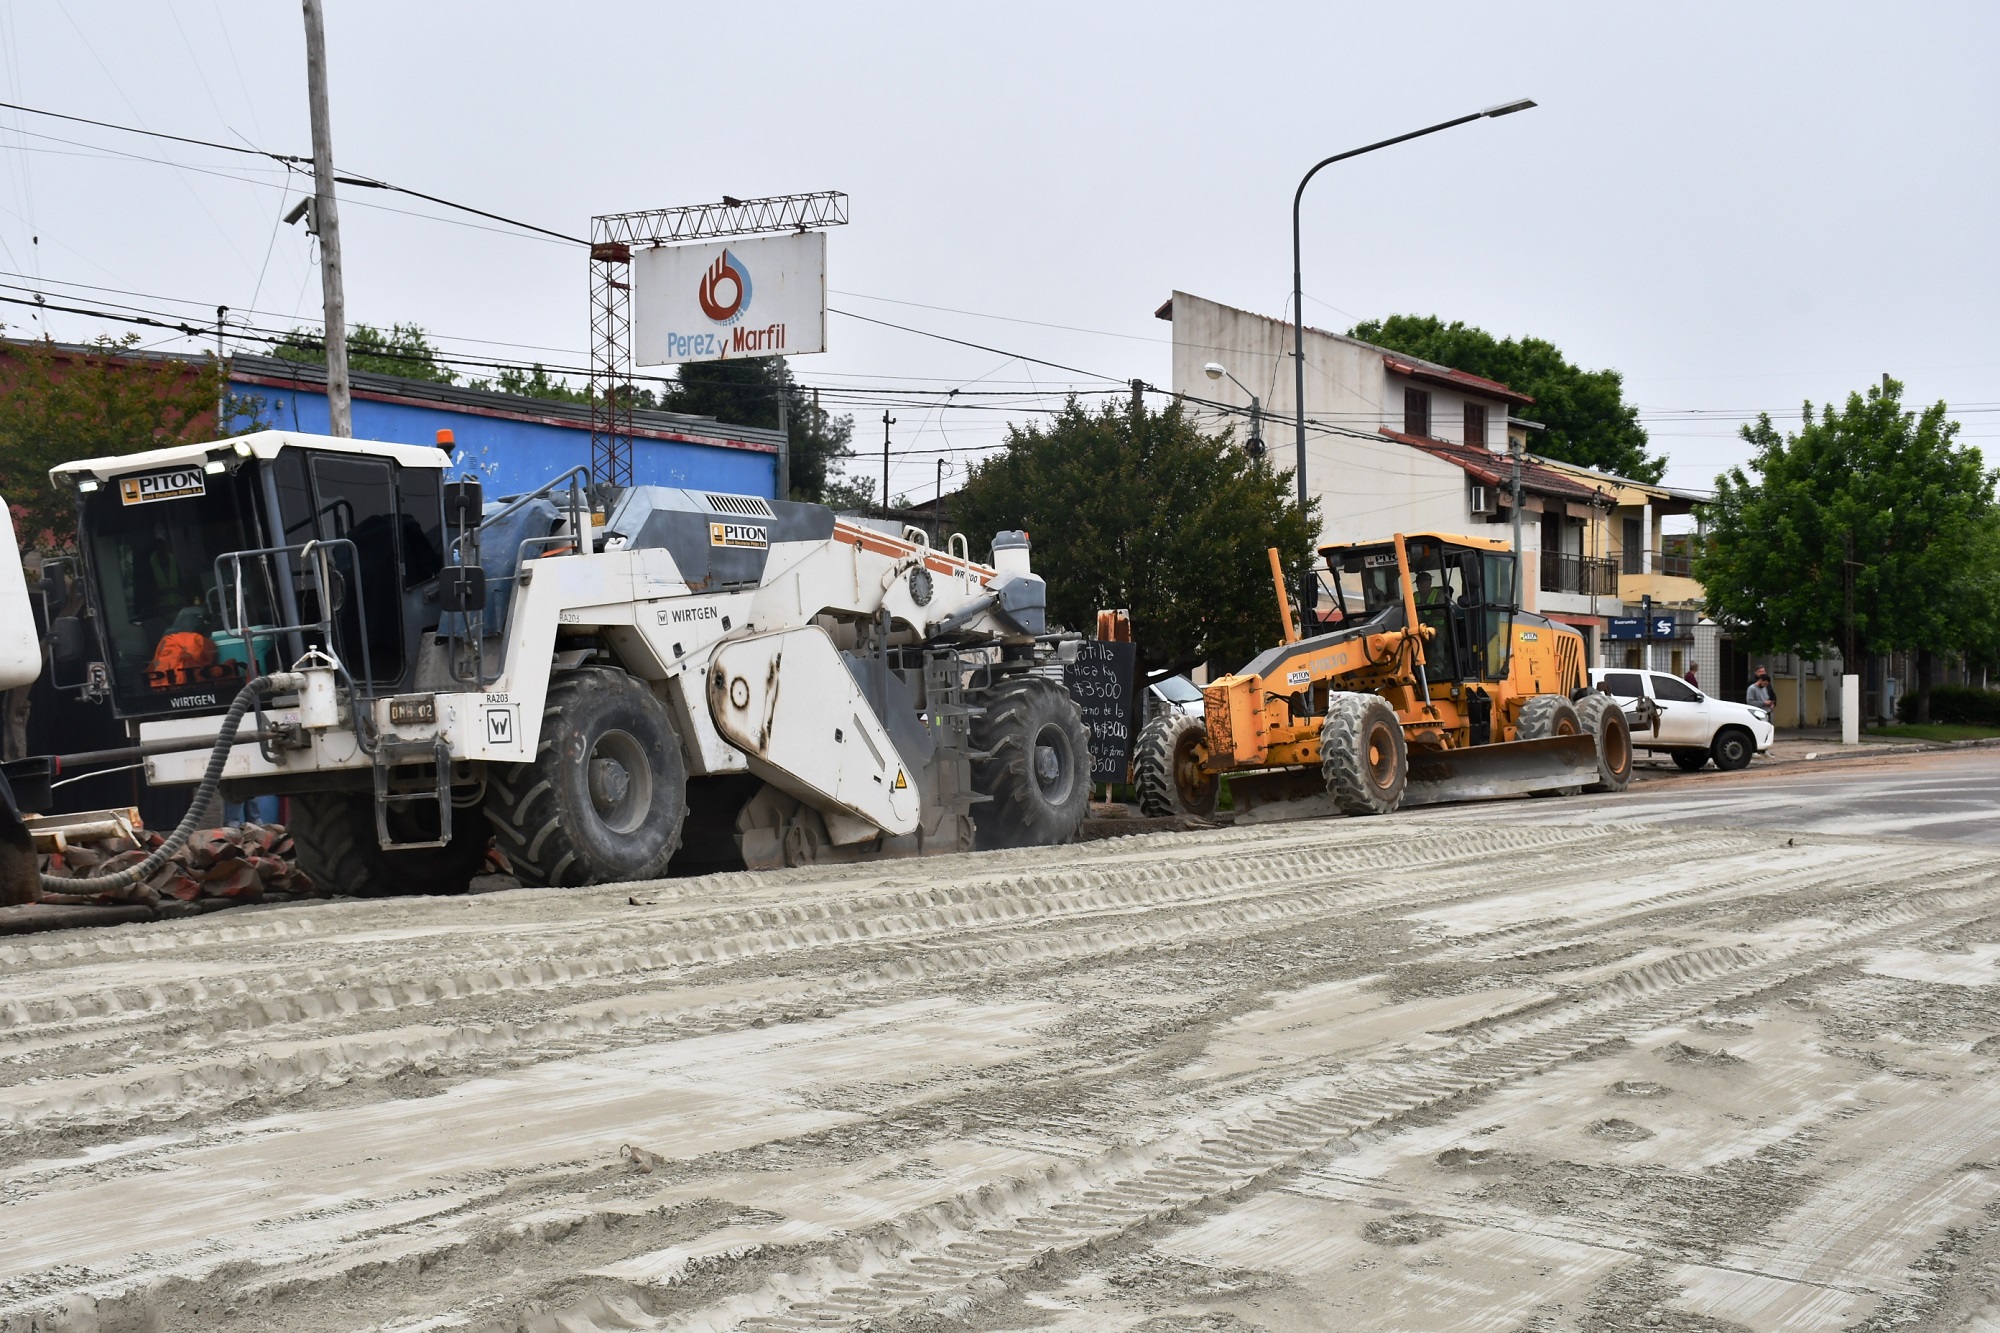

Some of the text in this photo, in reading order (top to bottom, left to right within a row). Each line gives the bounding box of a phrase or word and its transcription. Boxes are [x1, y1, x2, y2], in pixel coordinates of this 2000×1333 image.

[668, 323, 786, 360] Perez y Marfil
[139, 471, 203, 492] PITON
[725, 525, 767, 540] PITON
[671, 606, 718, 623] WIRTGEN
[1292, 671, 1310, 681] PITON
[170, 694, 216, 708] WIRTGEN
[486, 694, 509, 703] RA203
